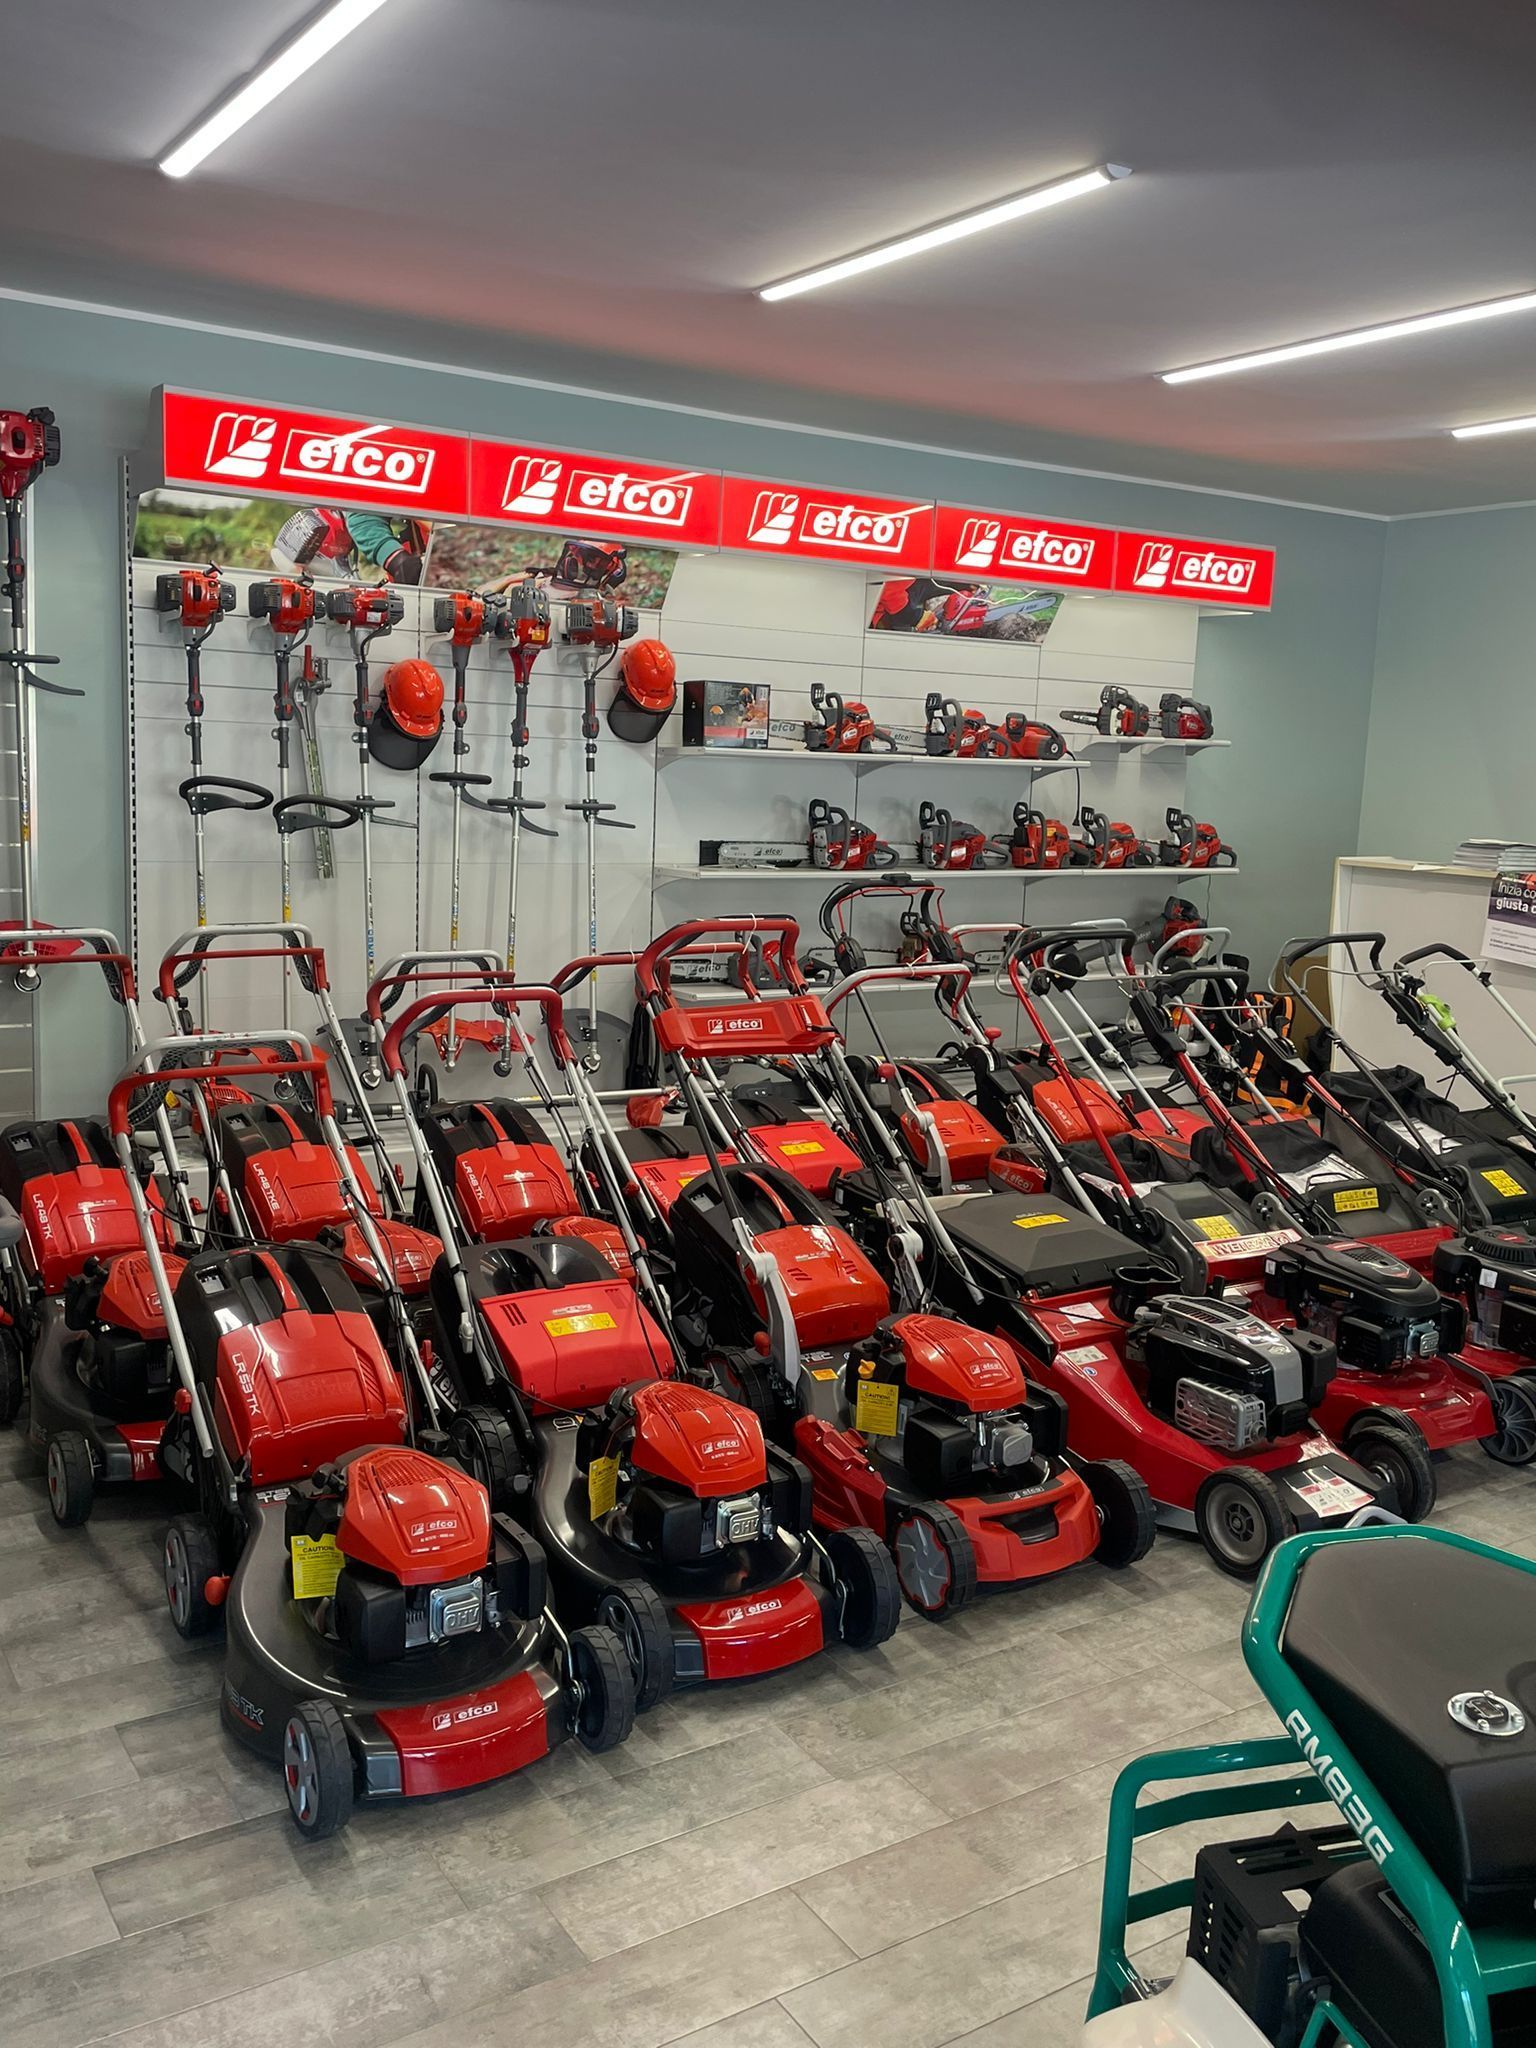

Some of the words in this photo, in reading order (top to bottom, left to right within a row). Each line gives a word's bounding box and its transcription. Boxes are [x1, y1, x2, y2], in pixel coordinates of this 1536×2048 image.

[579, 473, 677, 516] efco
[813, 505, 896, 545] efco
[1011, 530, 1084, 567] efco
[1182, 552, 1246, 585] efco
[1498, 881, 1522, 897] Inizia
[1495, 896, 1529, 913] giusta
[729, 1018, 760, 1031] efco
[246, 1393, 262, 1416] TK
[429, 1519, 454, 1529] efco
[747, 1601, 777, 1614] efco
[457, 1703, 493, 1720] efco
[1285, 1708, 1394, 1866] RM83G
